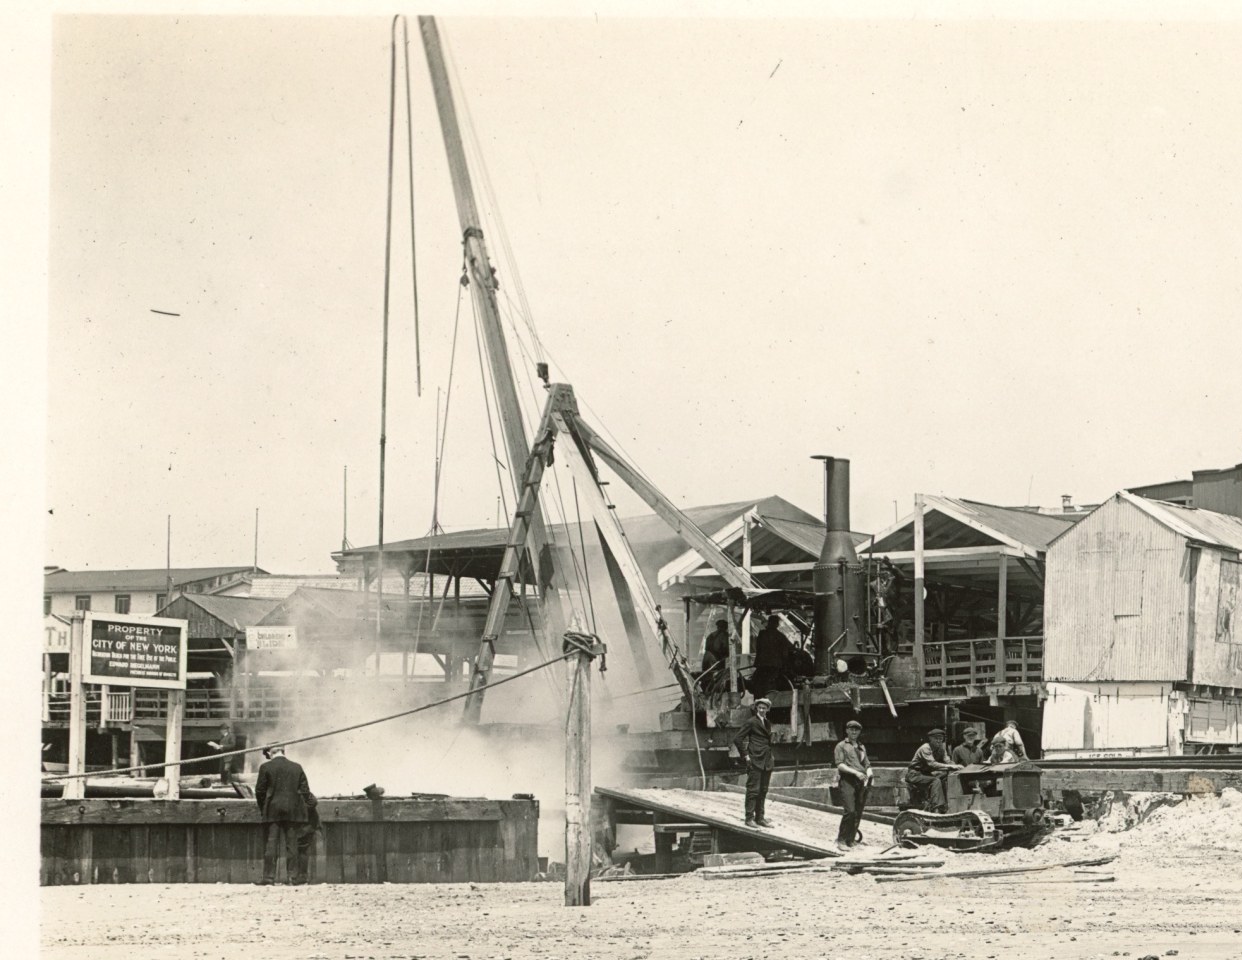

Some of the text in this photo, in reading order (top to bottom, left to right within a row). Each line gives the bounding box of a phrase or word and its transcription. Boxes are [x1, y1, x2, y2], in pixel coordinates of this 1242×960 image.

[108, 624, 163, 636] PROPERTY
[92, 639, 177, 654] CITY OF NEW YORK
